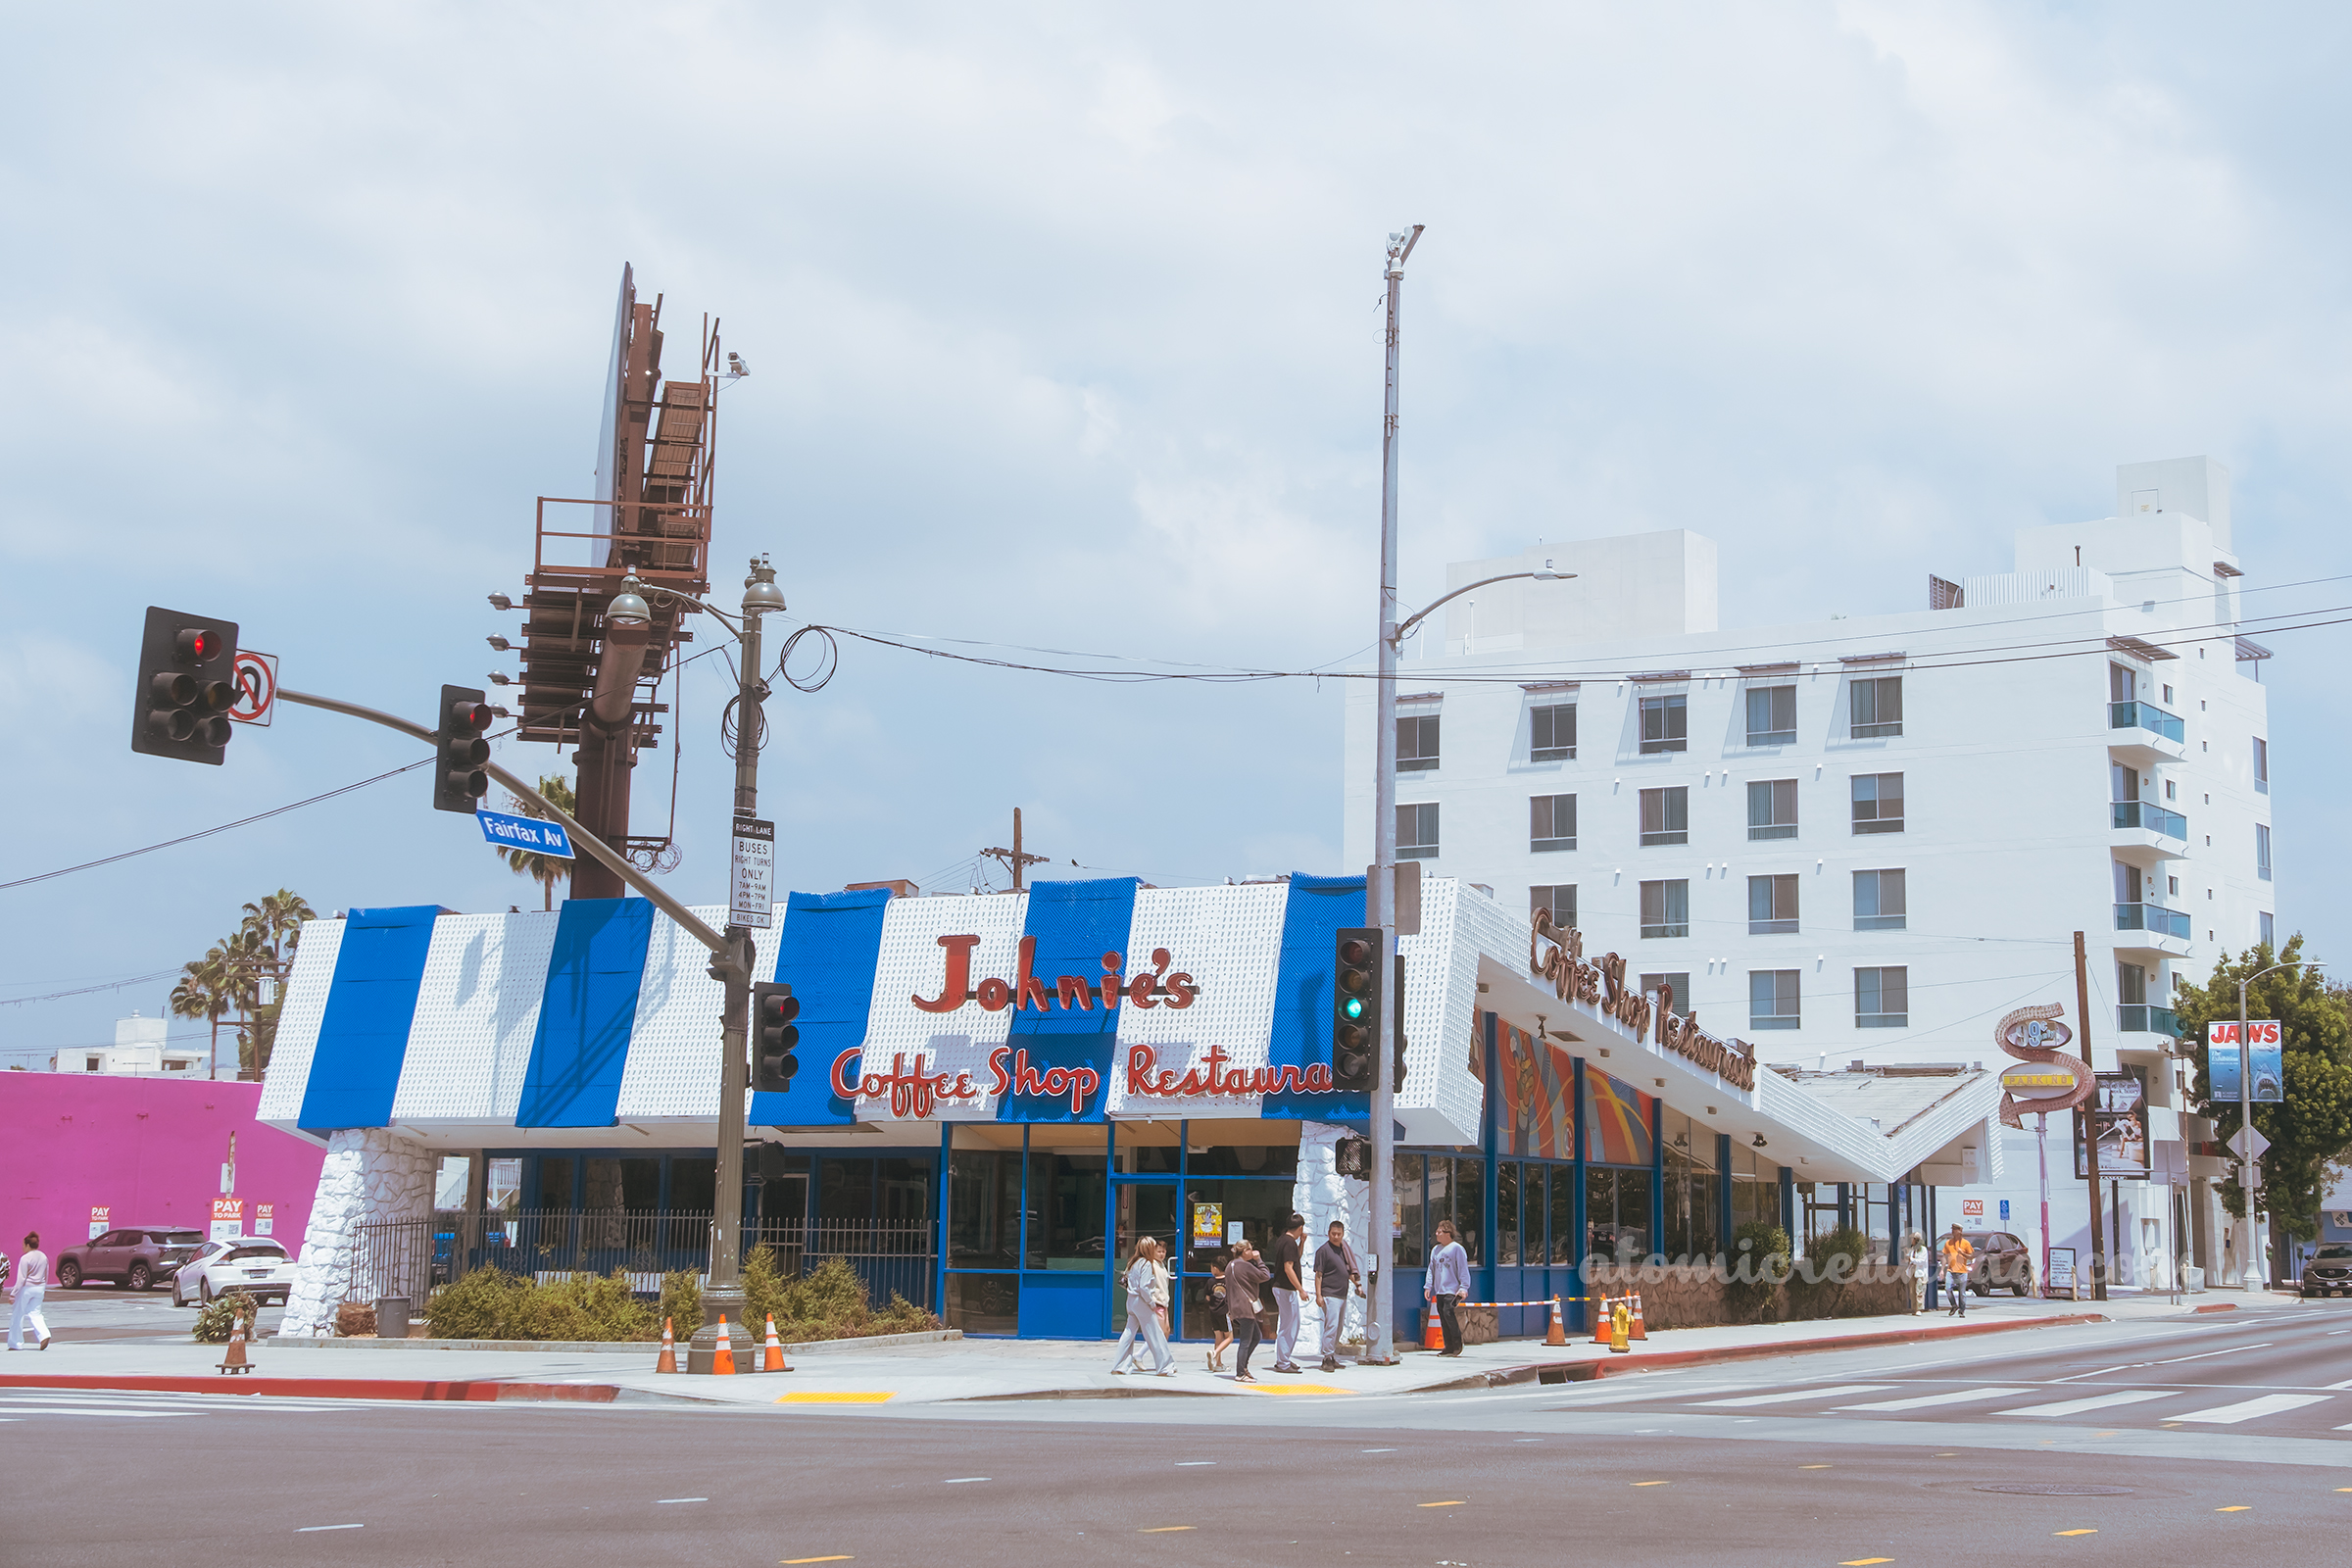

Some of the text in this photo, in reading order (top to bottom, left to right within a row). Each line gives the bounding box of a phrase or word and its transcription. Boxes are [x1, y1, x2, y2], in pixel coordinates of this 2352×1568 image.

[483, 816, 563, 848] Fairfax Av
[735, 823, 771, 836] RIGHT LANE
[739, 841, 768, 855] BUSES
[734, 855, 772, 867] RIGHT TURNS
[741, 867, 763, 880] ONLY
[738, 881, 766, 891] 7AM-9AM
[738, 891, 765, 901] 4PM-7PM
[738, 901, 764, 910] MON-FRI
[737, 913, 764, 924] BIKES OK
[911, 934, 1196, 1013] Johnie's
[1531, 906, 1757, 1092] Coffee Shop Restaurant
[2210, 1024, 2279, 1044] JAWS
[830, 1043, 1334, 1120] Coffee Shop Restaura
[2009, 1075, 2067, 1085] PARKING
[92, 1206, 110, 1216] PAY
[214, 1200, 242, 1212] PAY
[257, 1204, 273, 1213] PAY
[1964, 1200, 1983, 1210] PAY
